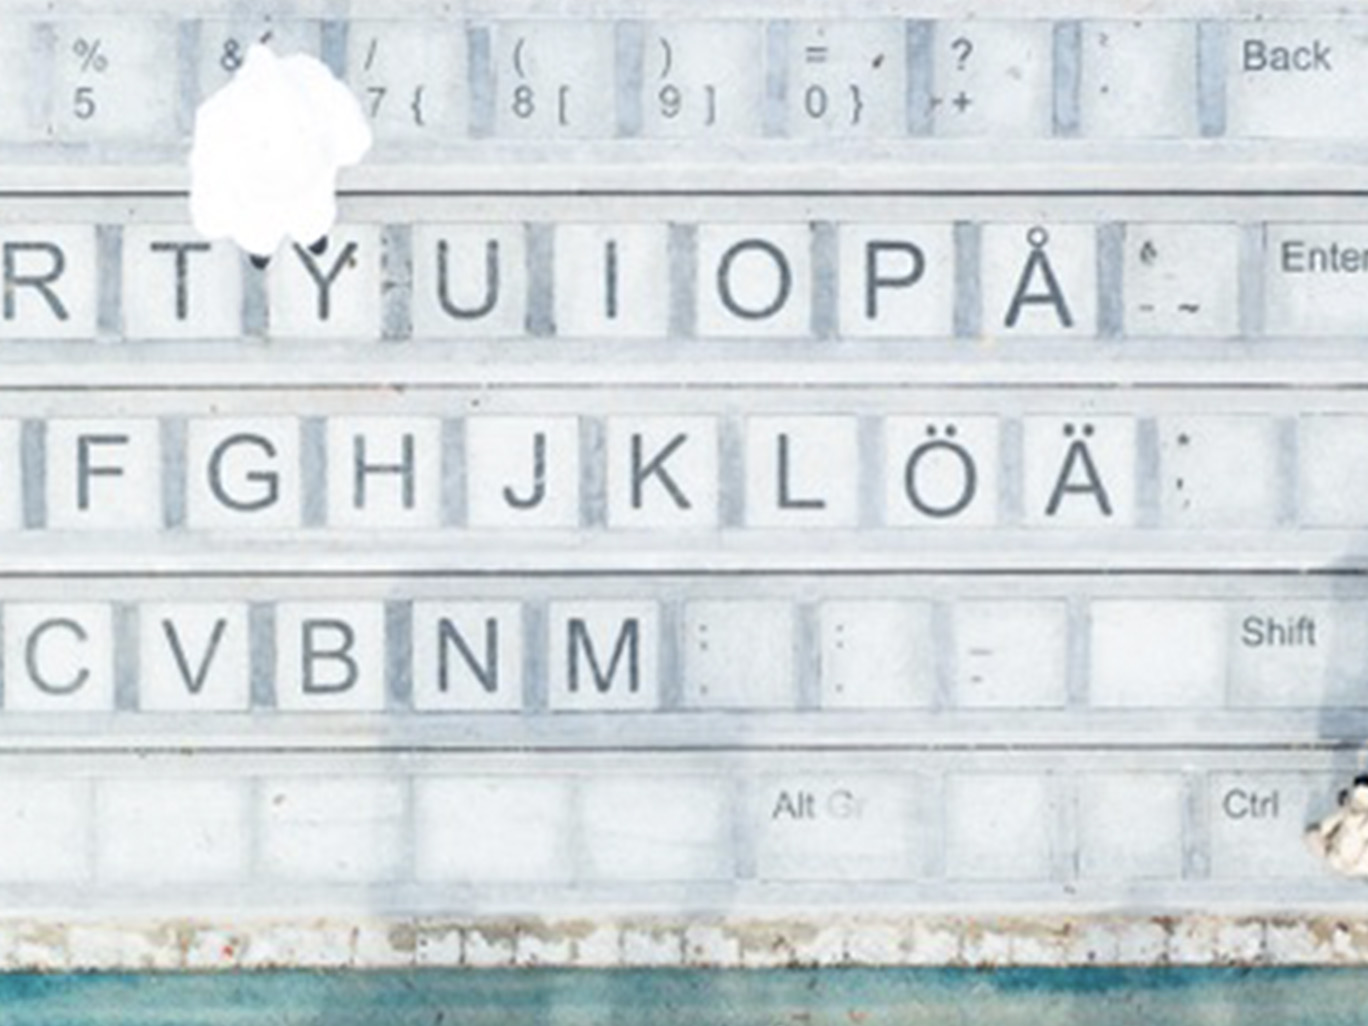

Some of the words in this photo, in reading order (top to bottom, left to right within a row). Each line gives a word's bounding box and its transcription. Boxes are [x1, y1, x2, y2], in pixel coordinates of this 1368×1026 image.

[72, 39, 108, 73] %
[513, 39, 526, 77] (
[660, 39, 672, 77] )
[950, 38, 974, 72] ?
[1243, 39, 1332, 72] Back
[74, 88, 96, 120] 5
[367, 88, 387, 118] 7
[512, 87, 536, 119] 8
[658, 87, 681, 119] 9
[2, 242, 69, 321] R
[149, 242, 211, 321] T
[292, 242, 359, 321] Y
[437, 240, 499, 319] U
[604, 240, 618, 319] I
[717, 238, 792, 320] O
[865, 240, 926, 320] P
[1003, 226, 1074, 329] Å
[77, 434, 130, 511] F
[207, 433, 280, 512] G
[353, 434, 415, 509] H
[502, 433, 547, 509] J
[631, 433, 692, 509] K
[776, 433, 827, 509] L
[904, 422, 977, 518] Ö
[1044, 422, 1114, 516] Ä
[25, 618, 91, 695] C
[161, 618, 228, 694] V
[301, 618, 359, 694] B
[436, 618, 498, 693] N
[567, 618, 640, 693] M
[1241, 615, 1317, 648] Shift
[772, 790, 815, 820] Alt
[826, 790, 868, 820] Gr
[1224, 788, 1279, 820] Ctrl
